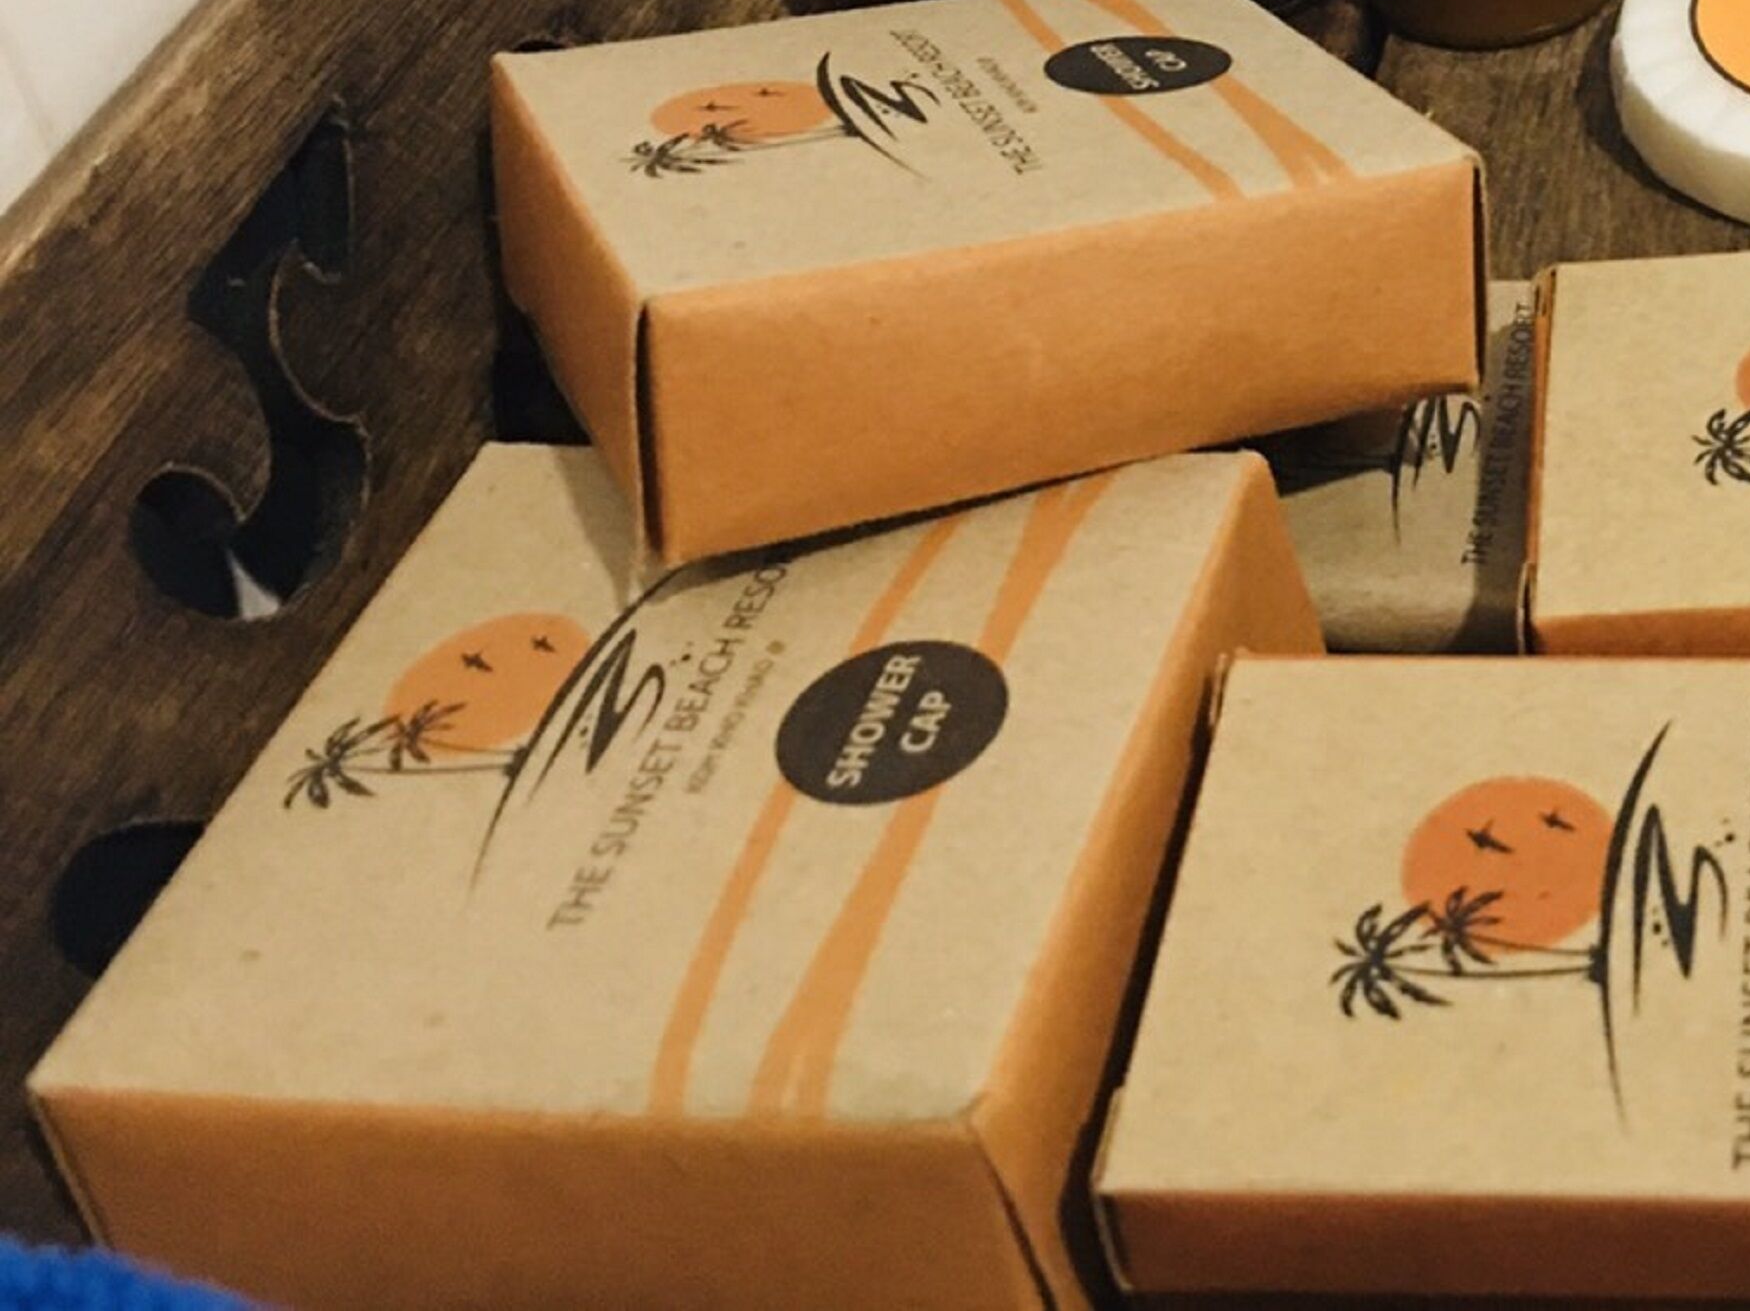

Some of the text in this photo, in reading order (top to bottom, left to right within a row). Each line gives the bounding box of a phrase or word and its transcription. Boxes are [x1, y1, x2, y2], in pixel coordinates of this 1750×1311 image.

[546, 564, 788, 931] THE SUNSET BEACH RESO
[827, 653, 922, 789] SHOWER
[899, 689, 954, 755] CAP
